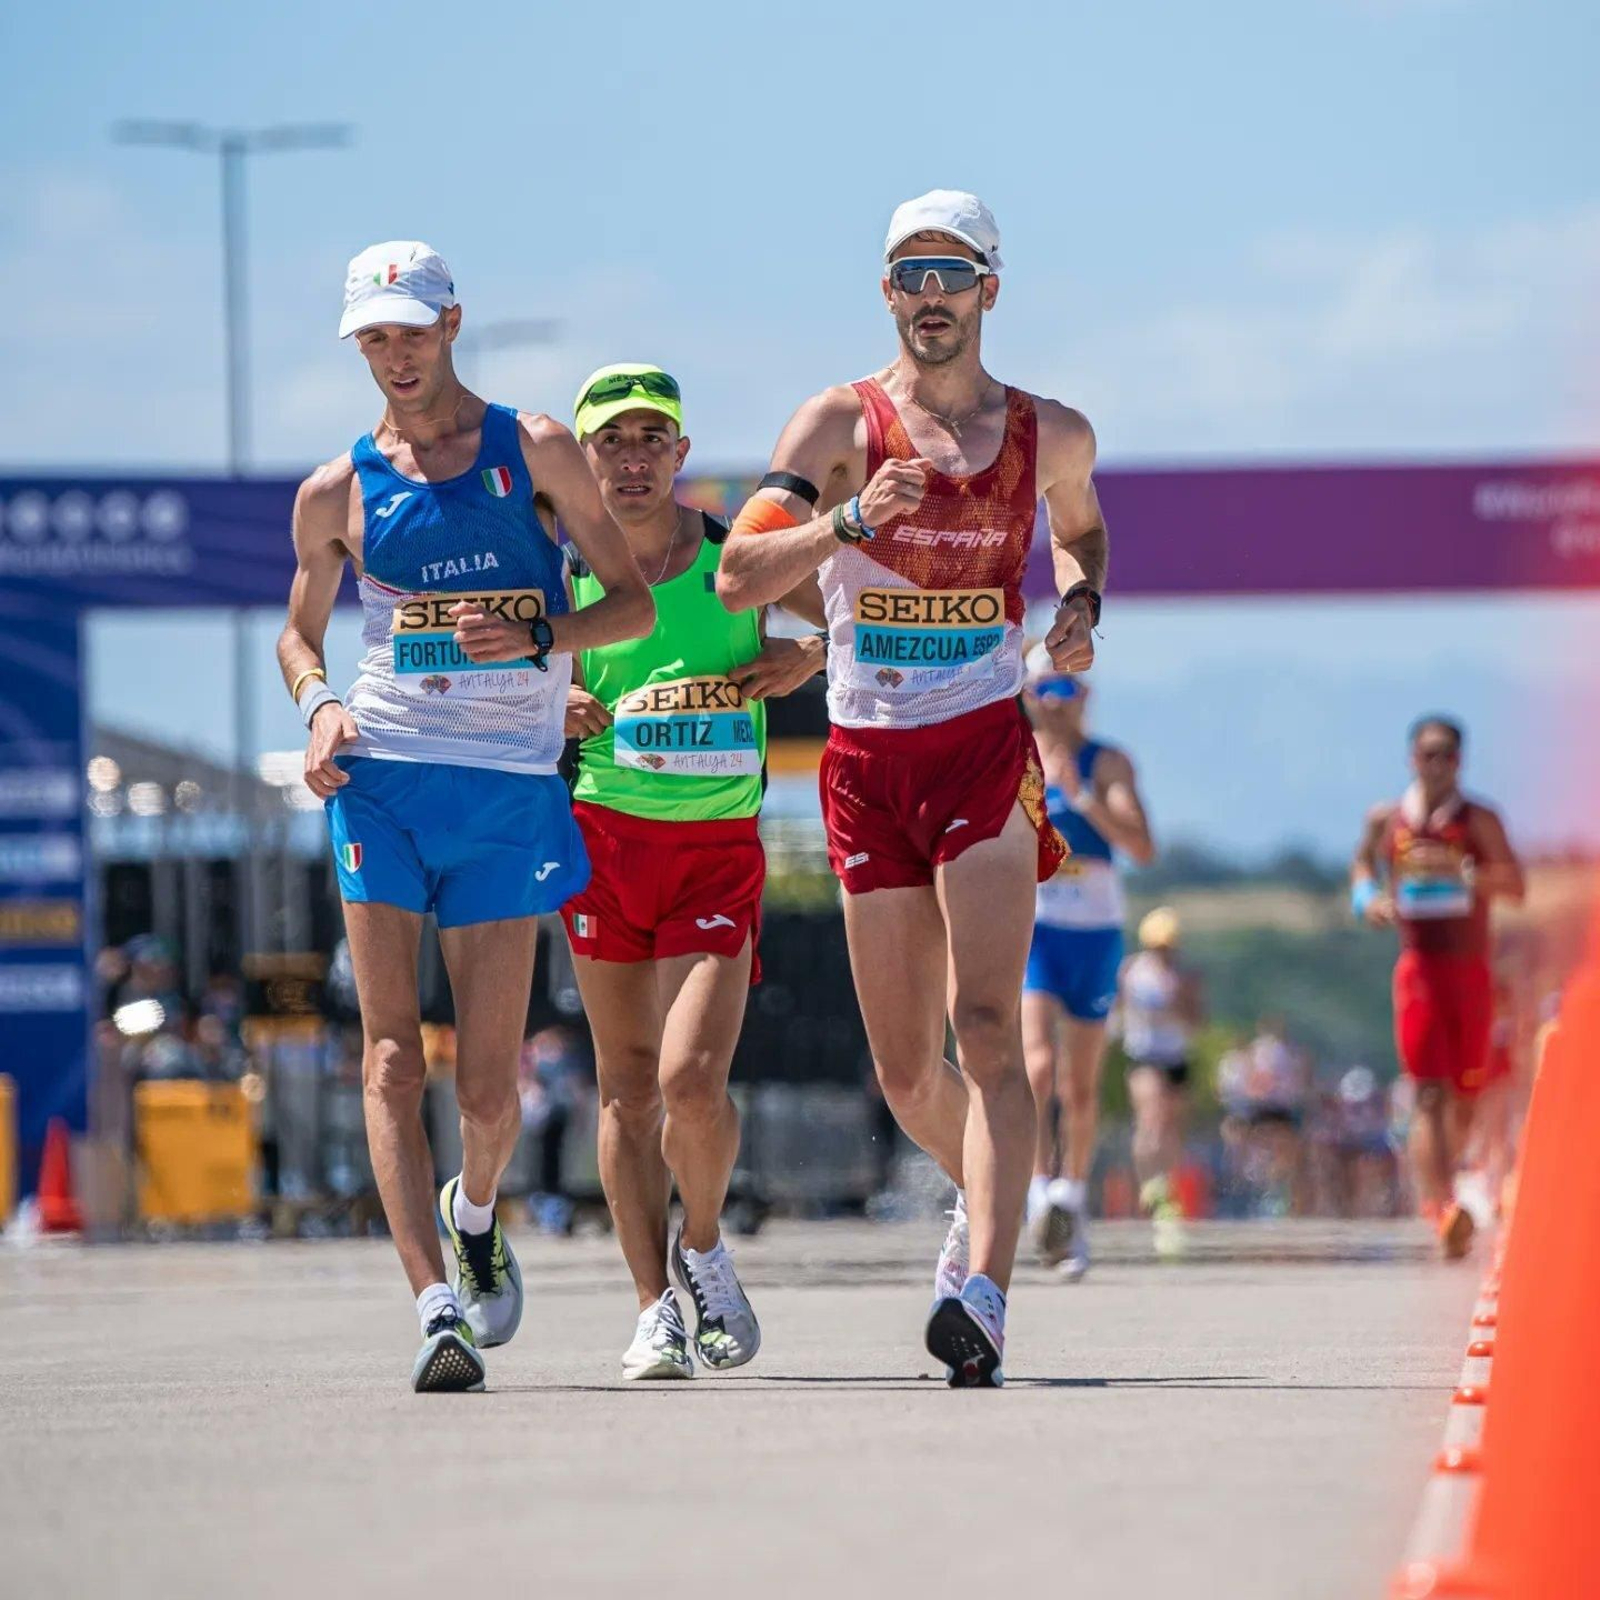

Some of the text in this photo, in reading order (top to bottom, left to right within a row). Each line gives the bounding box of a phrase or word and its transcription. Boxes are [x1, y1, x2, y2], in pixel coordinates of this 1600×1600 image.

[421, 552, 500, 583] ITALIA
[860, 592, 999, 623] SEIKO
[860, 632, 967, 661] AMEZCUA
[517, 671, 529, 687] 24
[621, 681, 743, 712] SEIKO
[636, 720, 714, 747] ORTIZ
[673, 753, 743, 773] ANTALYA 24
